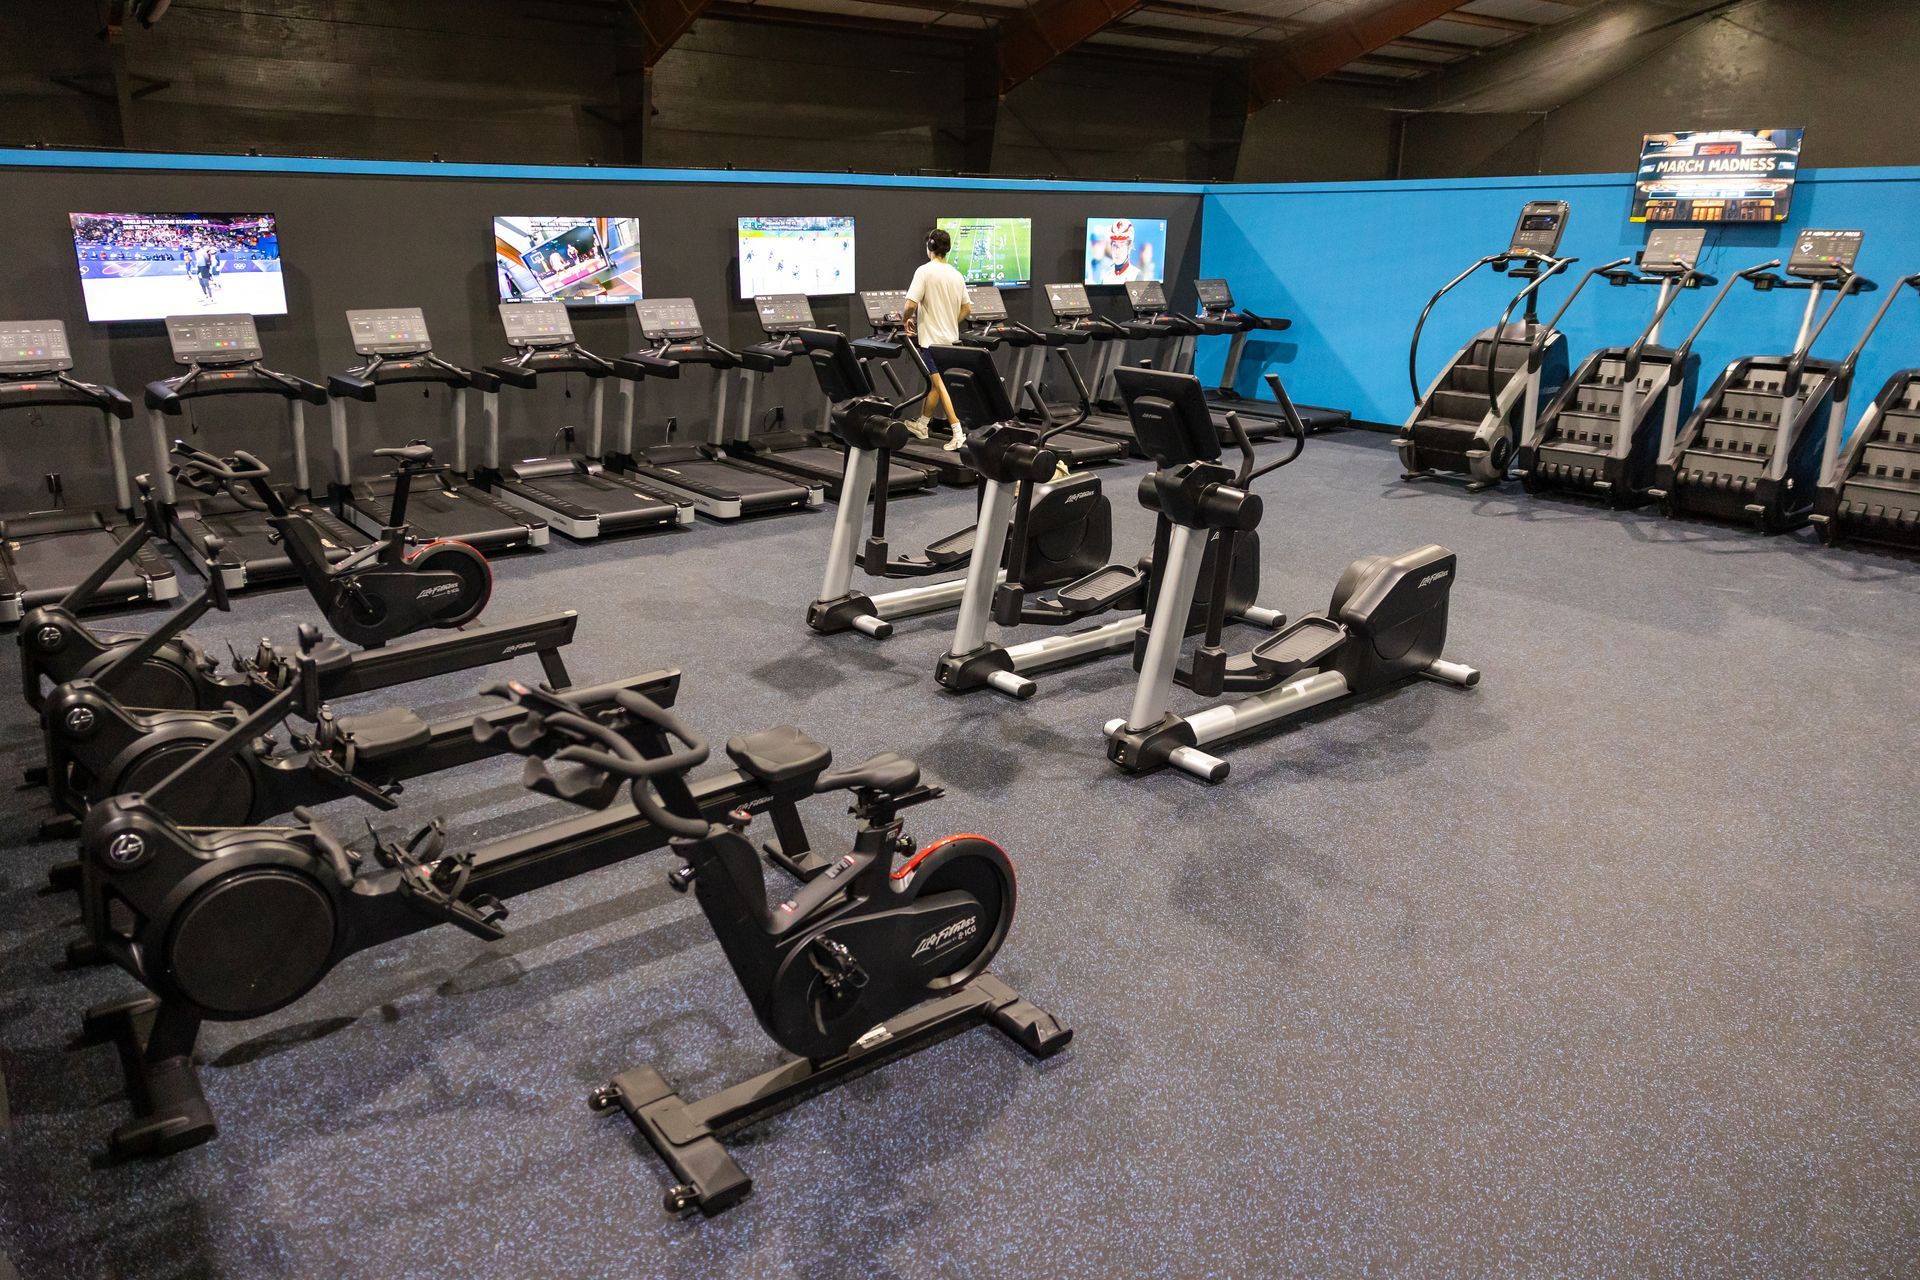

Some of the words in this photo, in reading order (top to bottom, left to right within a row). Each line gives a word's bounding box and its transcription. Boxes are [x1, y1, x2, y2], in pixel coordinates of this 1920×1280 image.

[1697, 144, 1738, 156] ESPN
[1656, 160, 1704, 173] MARCH
[1707, 157, 1777, 172] MADNESS
